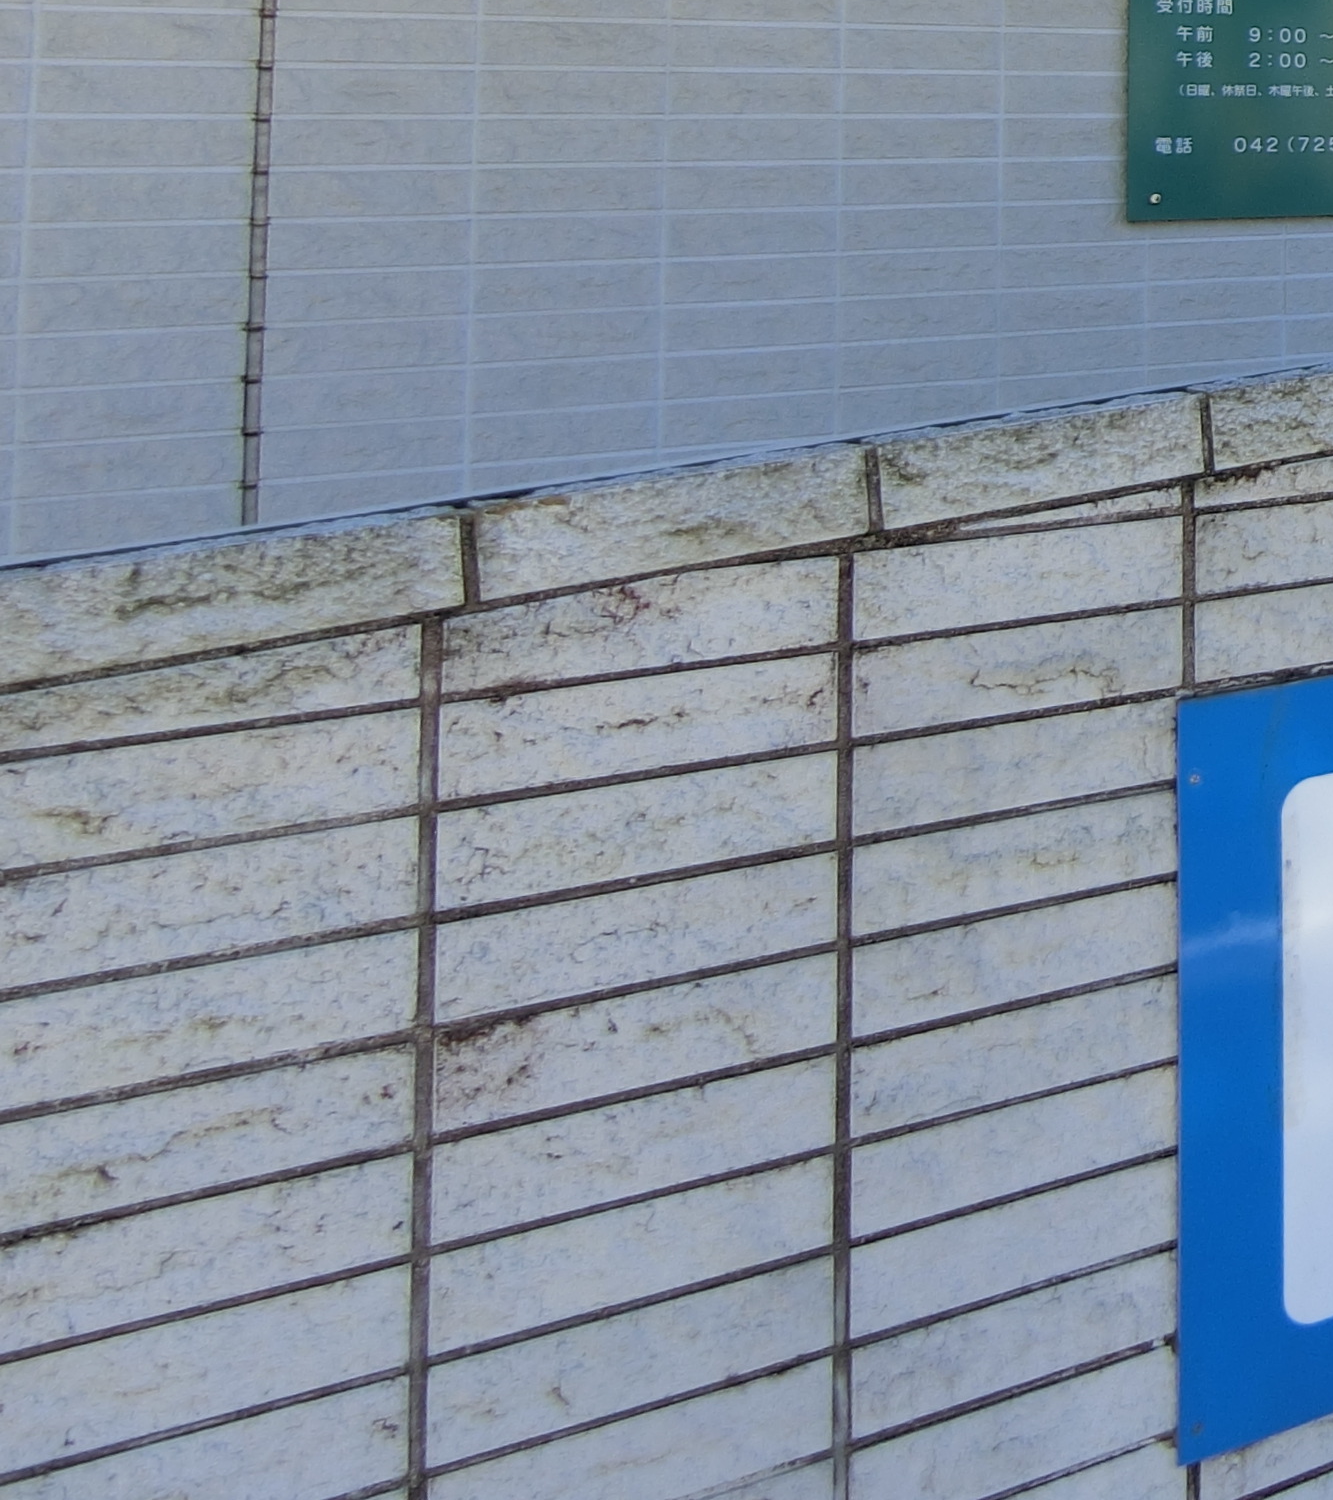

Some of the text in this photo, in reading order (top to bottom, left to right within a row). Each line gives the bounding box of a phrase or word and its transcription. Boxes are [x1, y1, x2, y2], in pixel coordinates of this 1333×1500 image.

[1176, 26, 1214, 42] 午前
[1176, 52, 1214, 68] 午後
[1155, 137, 1193, 154] 電話
